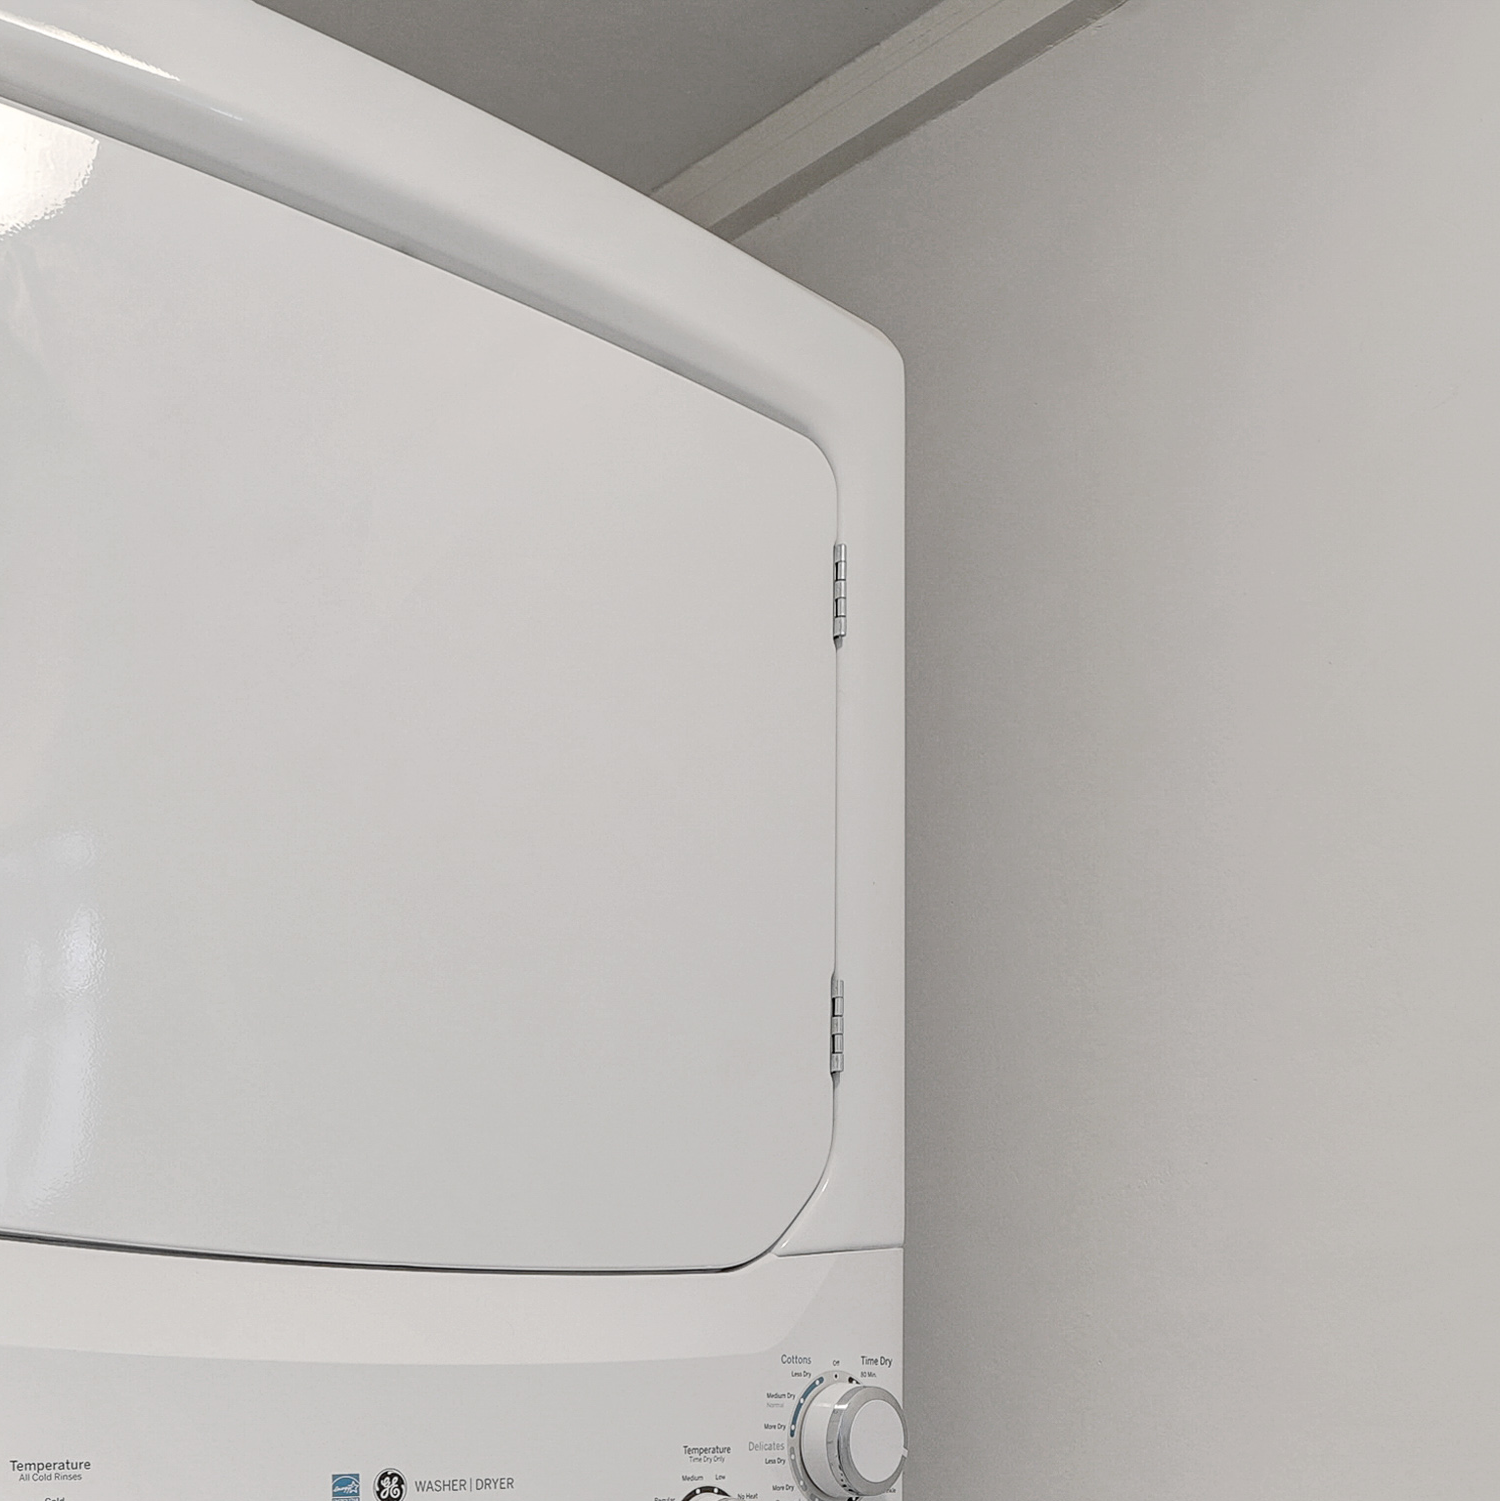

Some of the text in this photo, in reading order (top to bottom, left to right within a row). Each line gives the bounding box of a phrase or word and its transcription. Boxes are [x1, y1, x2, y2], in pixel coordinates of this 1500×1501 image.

[780, 1354, 812, 1365] Cottons
[861, 1356, 893, 1368] Time Dry
[787, 1392, 796, 1400] Dry
[777, 1423, 786, 1431] Dry
[683, 1445, 731, 1456] Temperature
[748, 1441, 785, 1452] Delicates
[9, 1459, 91, 1472] Temperature
[777, 1457, 786, 1465] Dry
[19, 1472, 82, 1481] All Cold Rinses
[415, 1477, 514, 1493] WASHER DRYER
[786, 1484, 795, 1492] Dry
